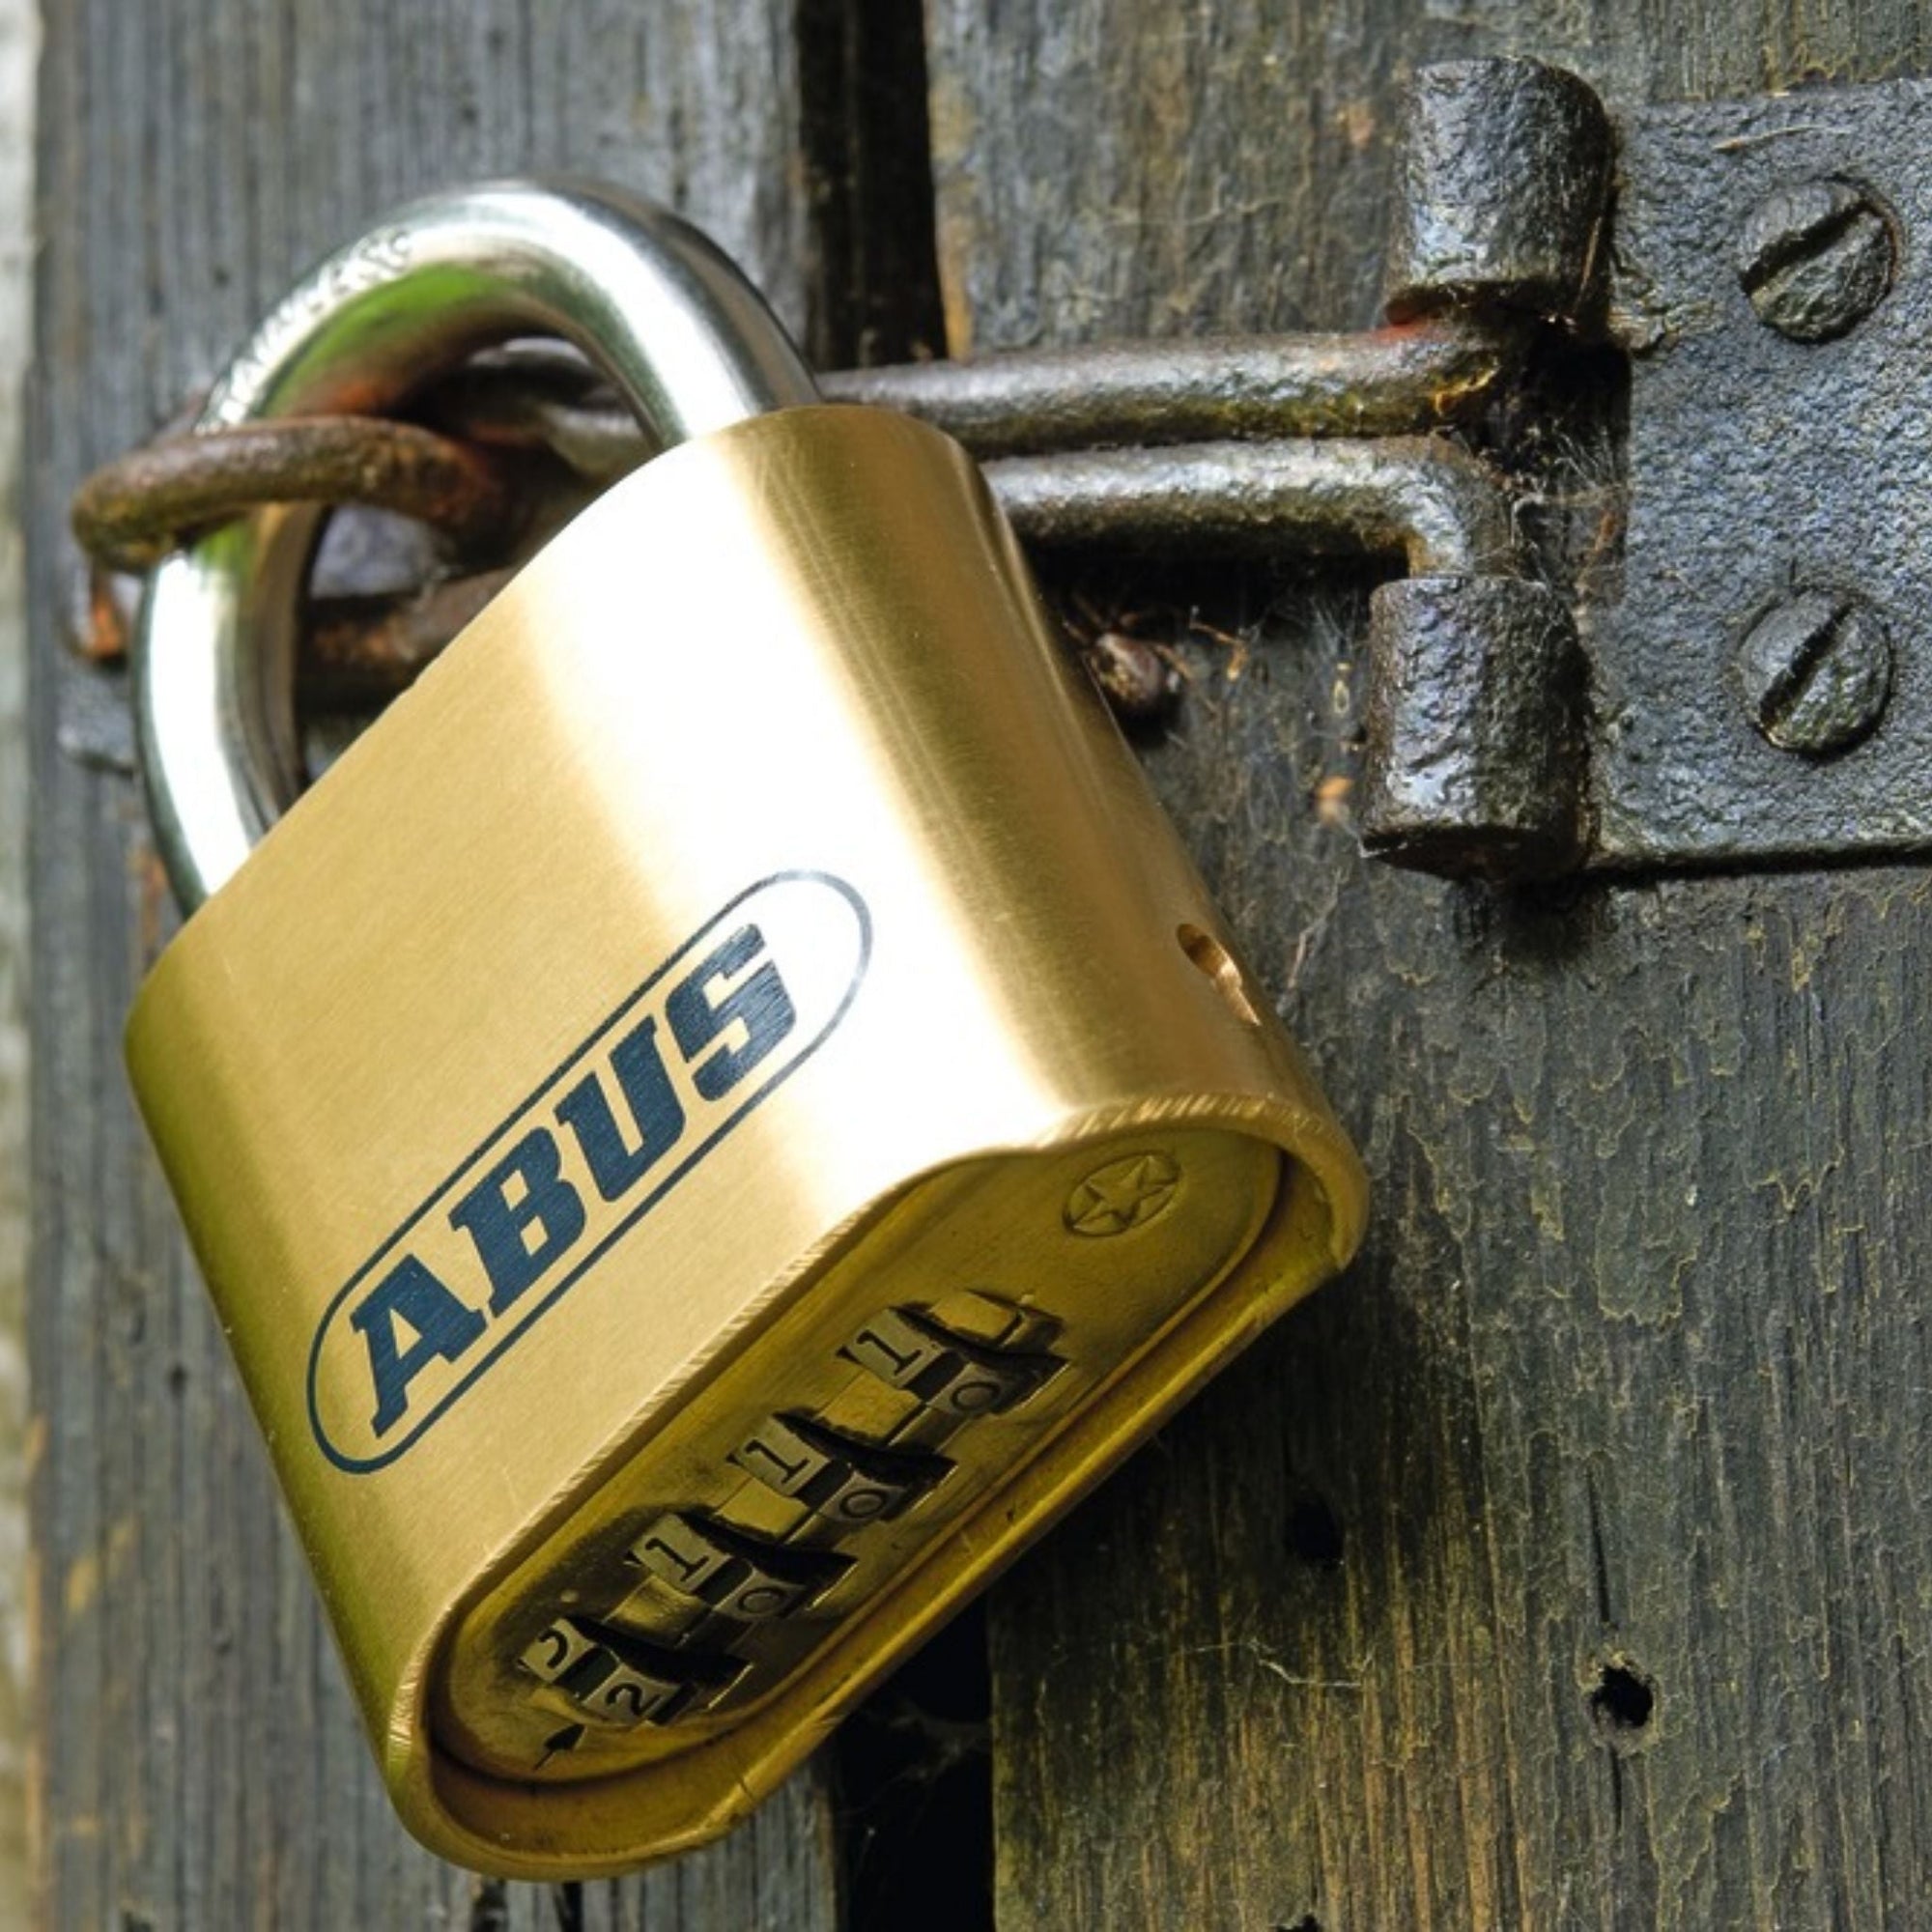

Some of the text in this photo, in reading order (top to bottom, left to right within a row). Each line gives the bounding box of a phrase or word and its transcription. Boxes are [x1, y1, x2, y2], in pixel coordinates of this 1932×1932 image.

[350, 923, 798, 1439] ABUS
[605, 1380, 1002, 1717] 2 0 0 0
[644, 1537, 710, 1582] 1
[744, 1438, 811, 1484] 1
[855, 1328, 923, 1377] 1
